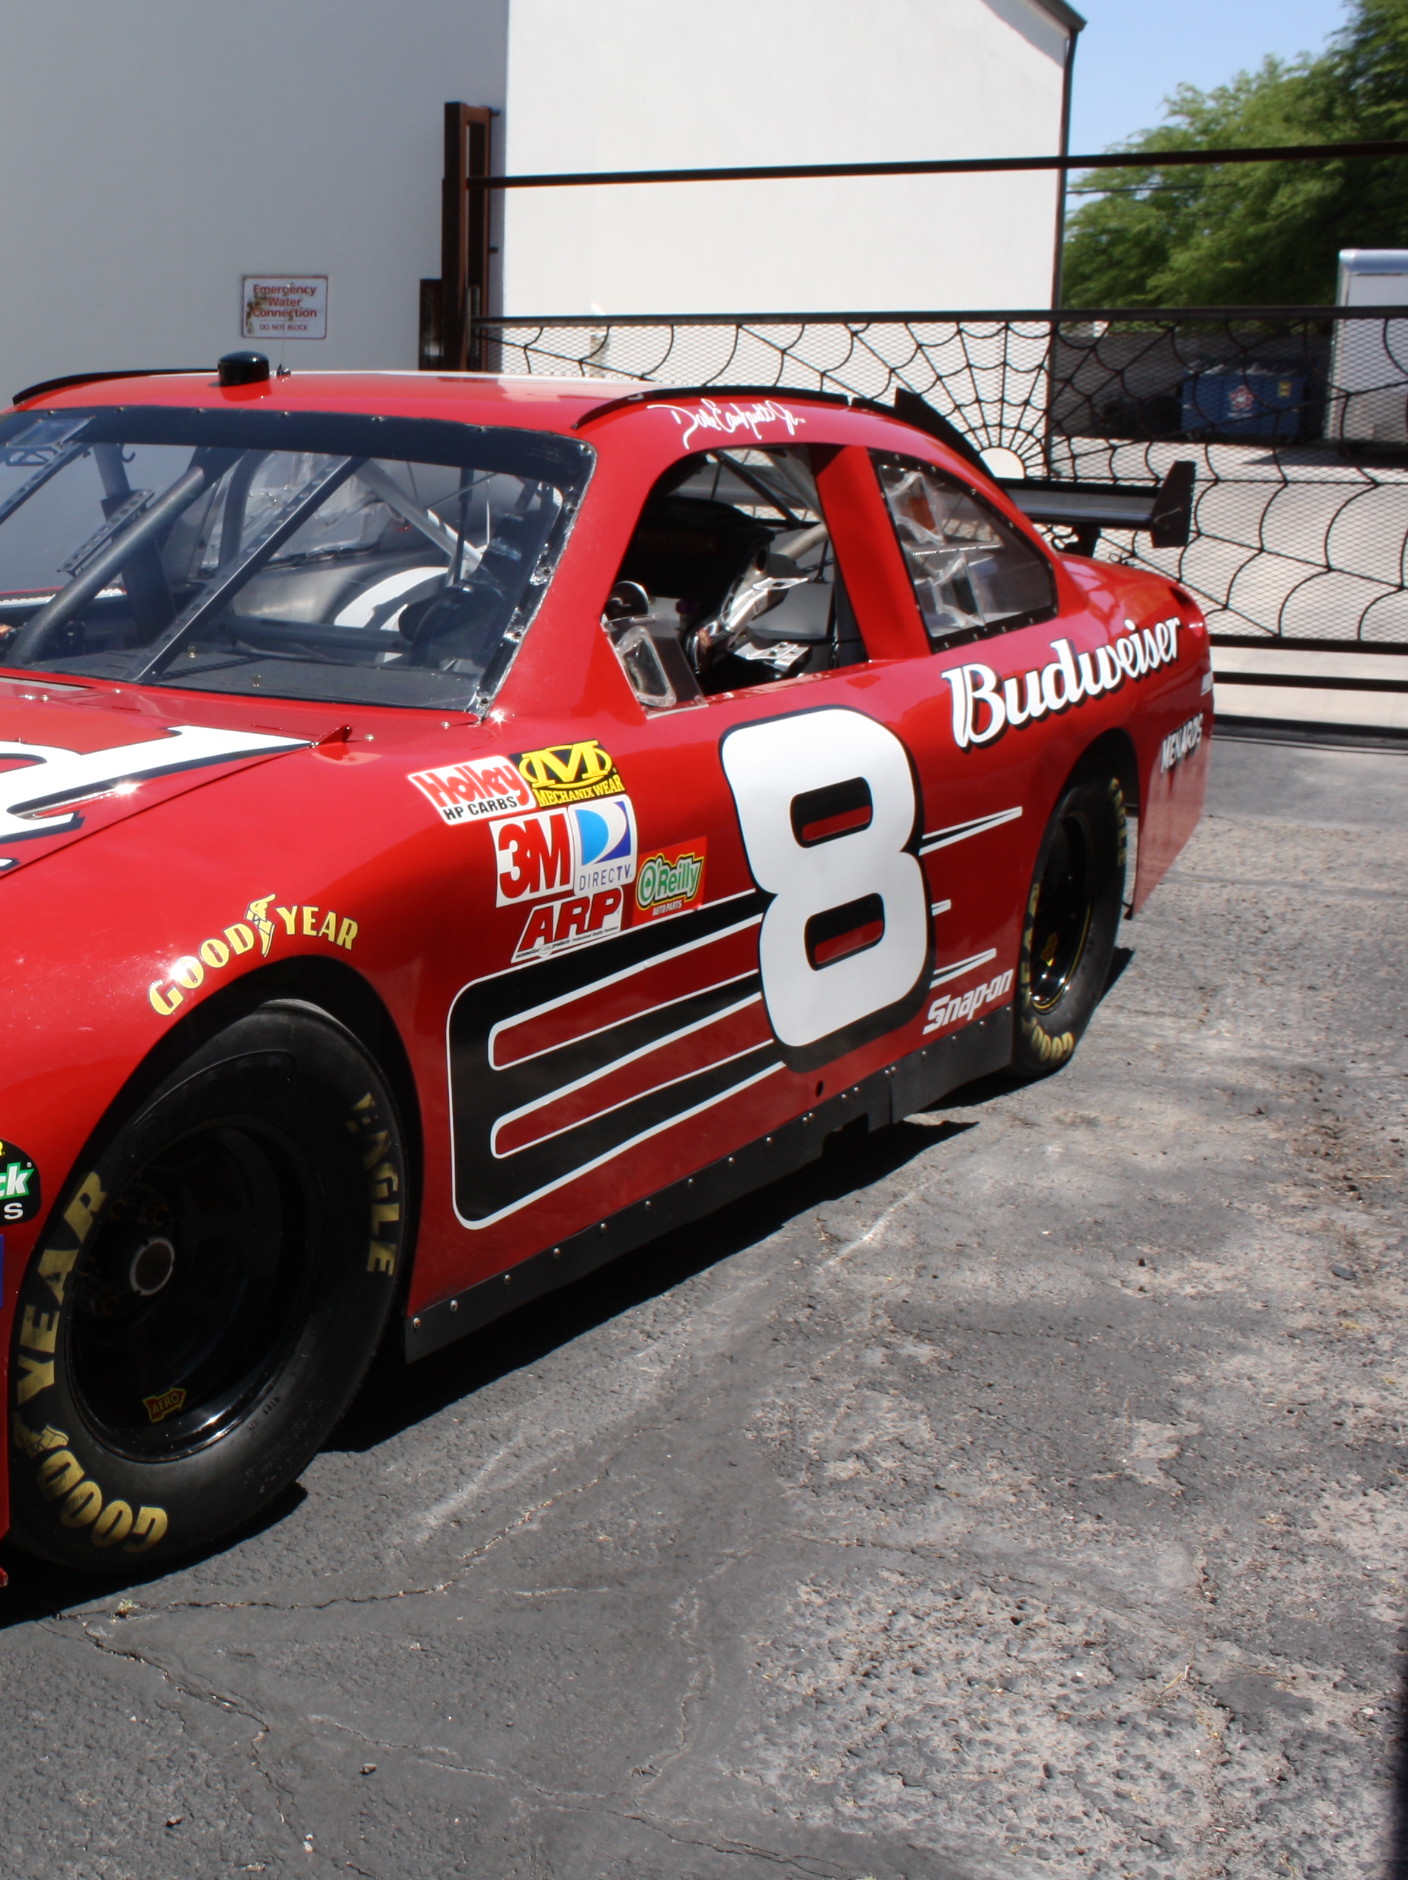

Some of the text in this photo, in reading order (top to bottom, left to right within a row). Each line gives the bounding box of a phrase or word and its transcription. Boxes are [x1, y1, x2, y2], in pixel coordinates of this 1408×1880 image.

[253, 284, 317, 296] Emergency
[268, 297, 302, 307] Water
[252, 309, 317, 318] Connection
[941, 616, 1181, 748] Budweiser
[412, 765, 530, 807] Holley
[532, 774, 626, 808] MECHANIX WEAR
[442, 796, 518, 820] HP CARBS
[498, 811, 571, 899] 3M
[579, 863, 632, 892] DIRECTV
[639, 855, 703, 906] O'Reilly
[721, 708, 929, 1047] 8
[517, 888, 622, 952] ARP
[922, 968, 1014, 1035] Snap-on
[152, 1392, 180, 1415] AERO
